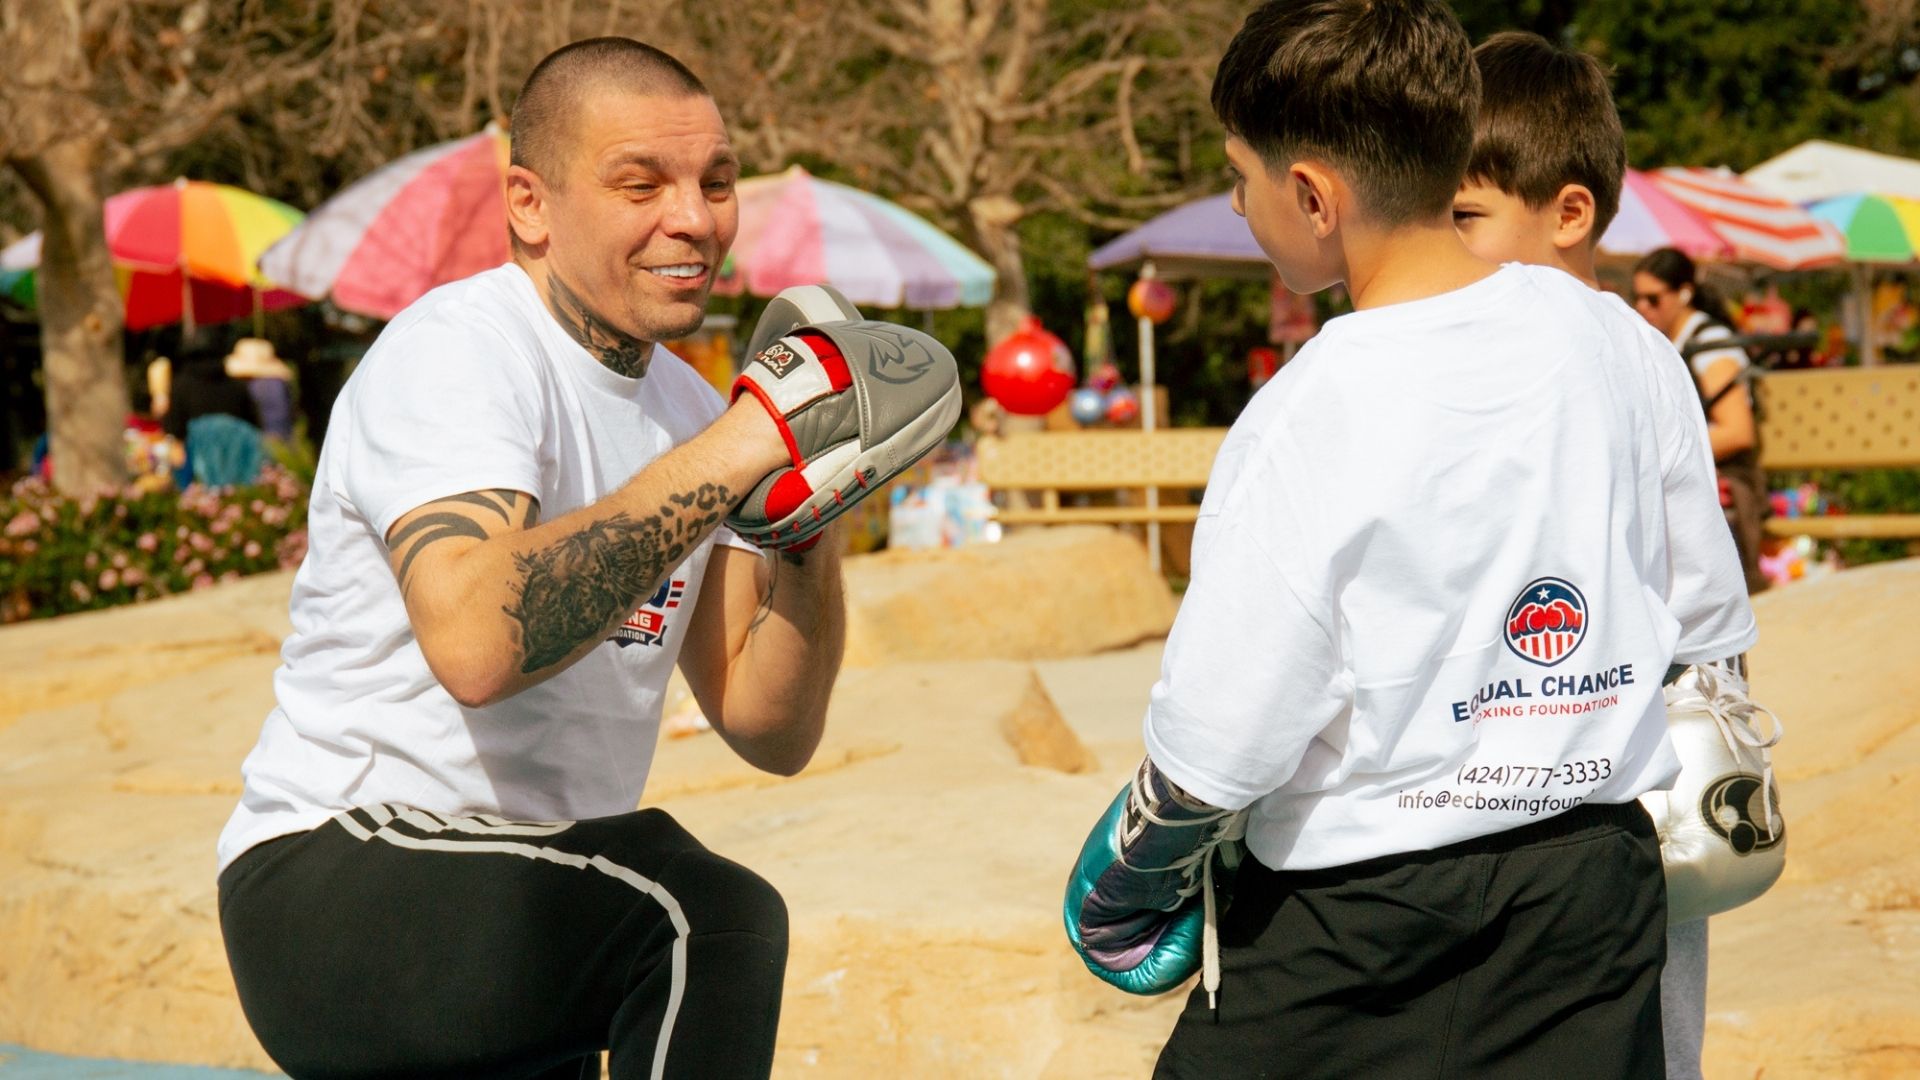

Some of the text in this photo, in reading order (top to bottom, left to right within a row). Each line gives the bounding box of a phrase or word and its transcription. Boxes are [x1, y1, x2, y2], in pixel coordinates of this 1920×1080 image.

[1452, 663, 1635, 723] EQUAL CHANCE
[1473, 694, 1618, 730] OXING FOUNDATION
[1457, 758, 1612, 789] (424)777-3333
[1398, 788, 1595, 816] info@ecboxingfoun
